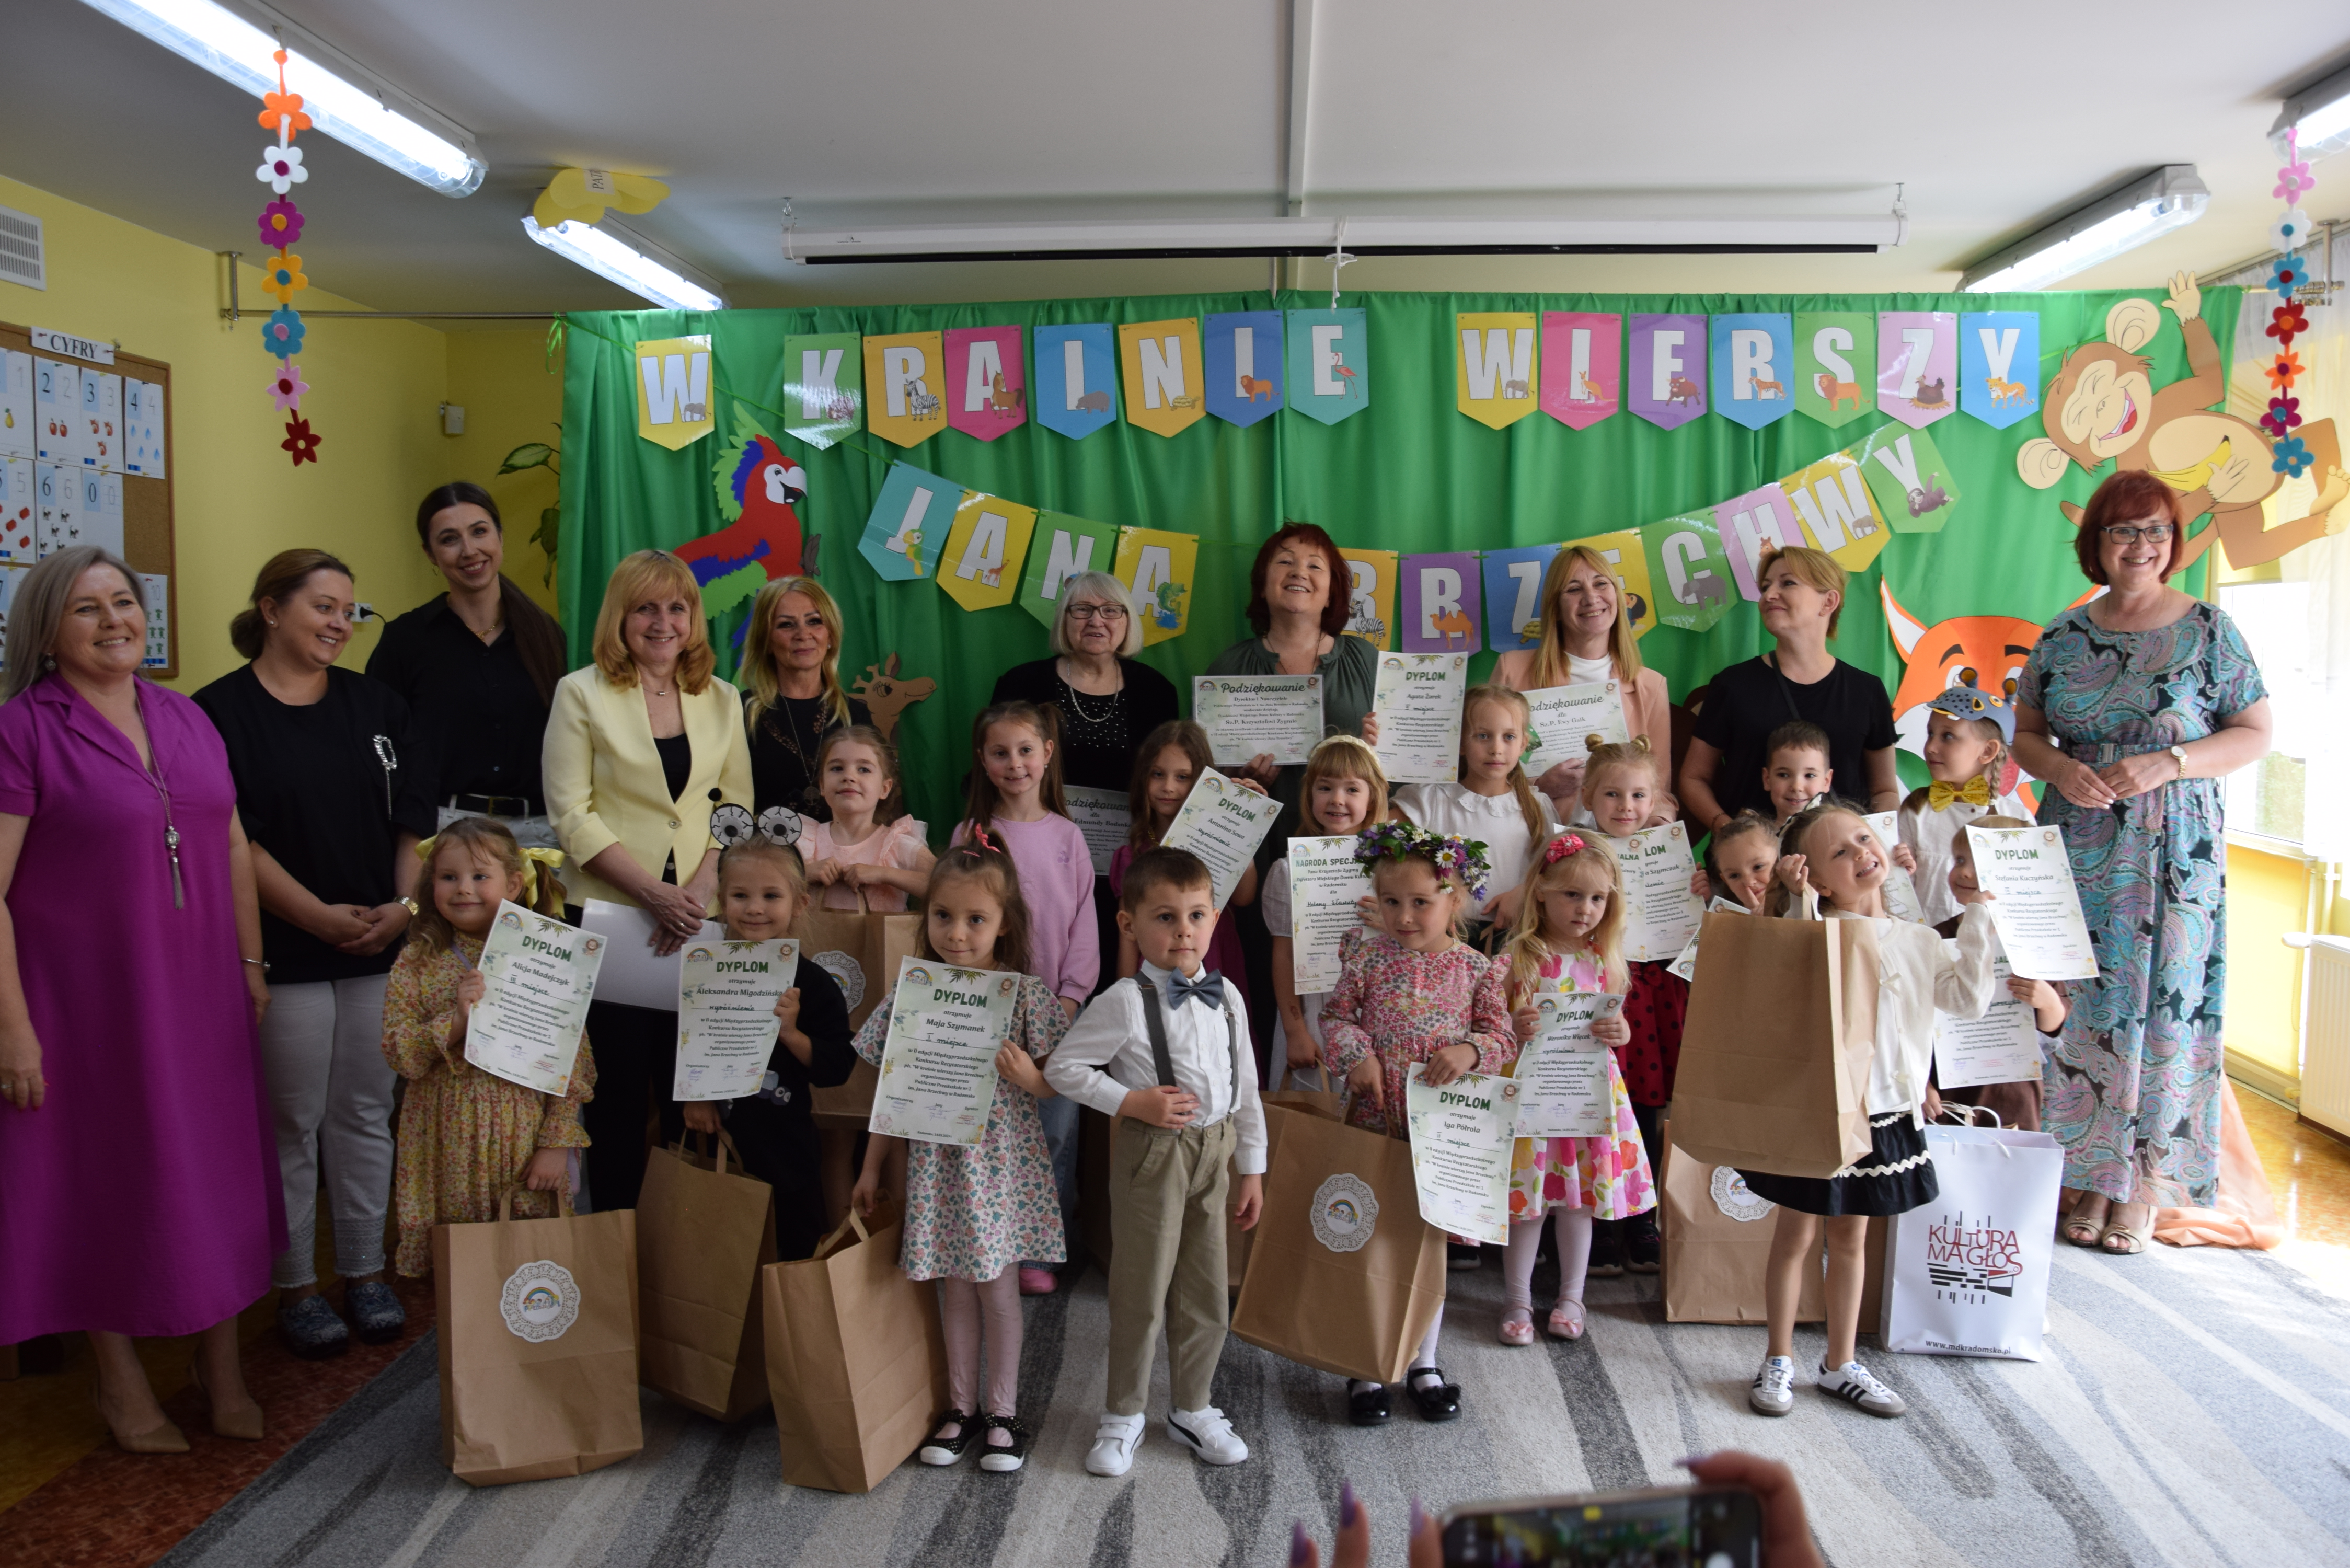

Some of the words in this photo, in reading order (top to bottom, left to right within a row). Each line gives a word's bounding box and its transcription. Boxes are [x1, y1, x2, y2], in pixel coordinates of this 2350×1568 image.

[51, 335, 98, 359] CYFRY
[641, 352, 709, 424] W
[801, 325, 1346, 420] KRAINIE
[1461, 327, 2021, 402] WIERSZY
[42, 373, 50, 393] 2
[87, 383, 95, 402] 3
[131, 393, 137, 411] 4
[43, 477, 51, 496] 6
[89, 483, 97, 502] 0
[885, 486, 1172, 617] JANA
[1221, 683, 1305, 695] Podziękowanie
[1531, 695, 1604, 711] odziękowanie
[1066, 798, 1128, 811] odziękowan
[1218, 798, 1255, 822] DYPLOM
[1222, 816, 1240, 826] otrzymuje
[1208, 818, 1231, 833] Antonina
[1231, 830, 1245, 839] Sowa
[1995, 849, 2038, 860] DYPLOM
[1650, 864, 1679, 874] Szymczak
[2016, 888, 2042, 897] miejsce
[522, 936, 572, 961] DYPLOM
[530, 958, 556, 969] otrzymuje
[717, 961, 768, 973] DYPLOM
[512, 962, 531, 973] Alicja
[533, 969, 569, 985] Madejczyk
[521, 983, 549, 996] miejsce
[934, 989, 987, 1007] DYPLOM
[1556, 1010, 1594, 1022] DYPLOM
[926, 1019, 945, 1028] Maja
[947, 1022, 985, 1032] Szymanek
[936, 1038, 968, 1048] miejsce
[934, 1052, 988, 1063] Międzyprzedszkolnego
[941, 1061, 978, 1070] Recytatorskiego
[1440, 1092, 1490, 1110] DYPLOM
[1457, 1124, 1480, 1133] Półrola
[1447, 1139, 1470, 1148] miejsce
[1446, 1151, 1495, 1165] Międzyprzedszkolnego
[1453, 1160, 1487, 1170] Recytatorskiego
[1439, 1171, 1469, 1180] organizowanego
[1446, 1184, 1464, 1193] Brzechwy
[1929, 1225, 2020, 1254] KULTURA
[1927, 1243, 1964, 1264] MA
[1966, 1247, 2023, 1271] GŁOS
[1926, 1340, 2011, 1355] www.mdkradomsko.pl
